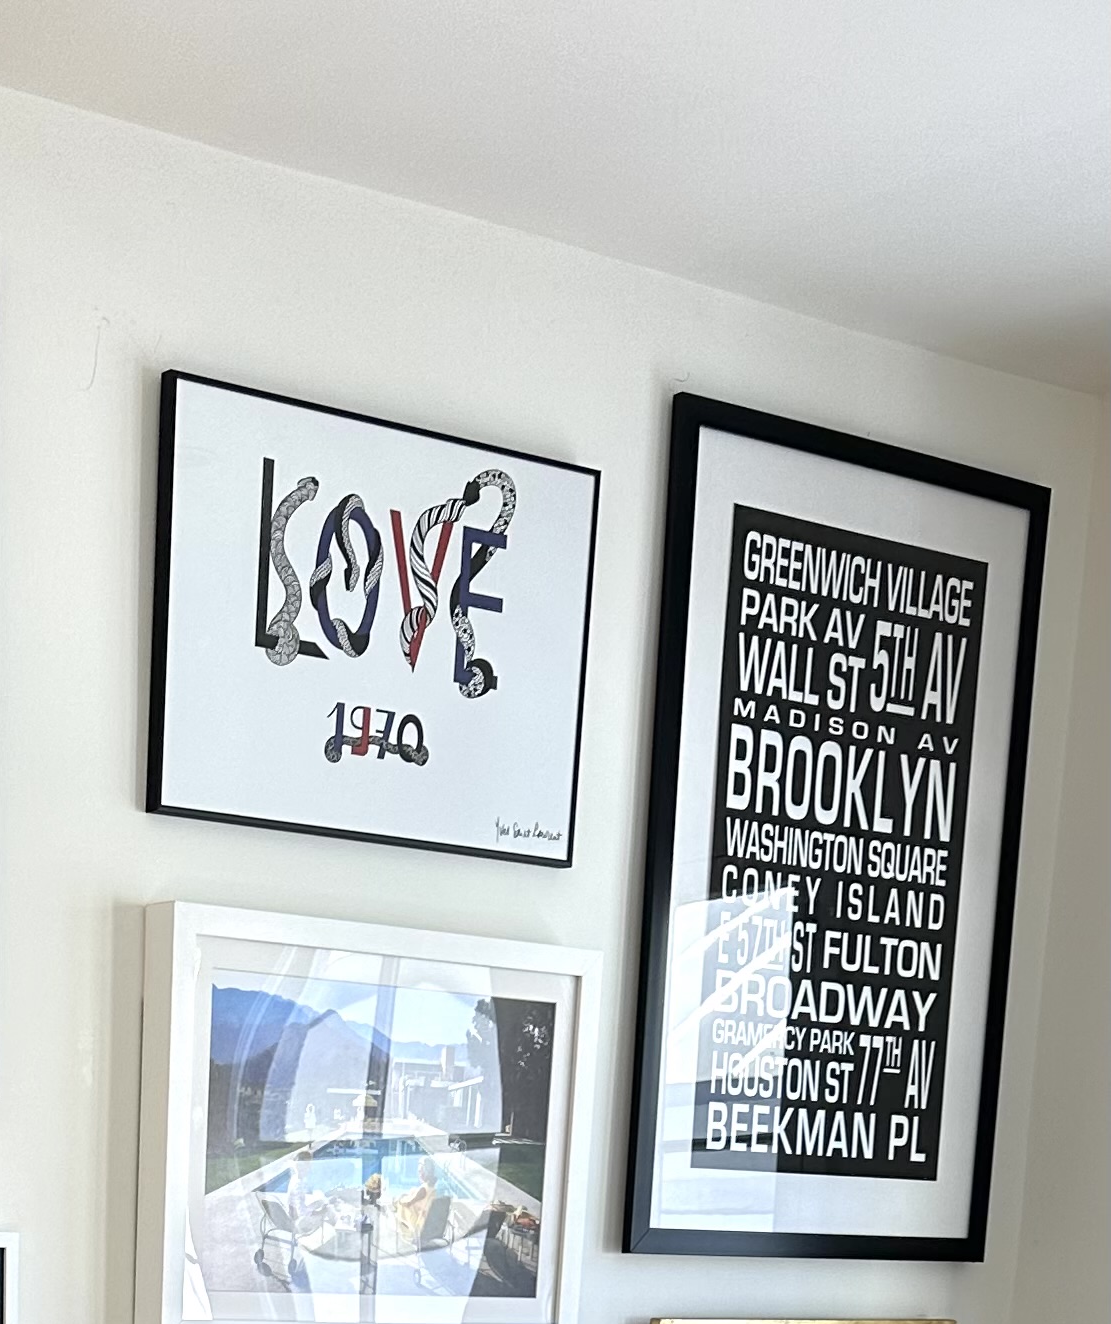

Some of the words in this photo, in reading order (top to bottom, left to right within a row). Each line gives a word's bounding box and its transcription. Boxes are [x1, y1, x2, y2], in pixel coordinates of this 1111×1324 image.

[255, 456, 516, 699] LOVE
[743, 530, 882, 608] GREENWICH
[888, 563, 974, 627] VILLAGE
[740, 587, 820, 641] PARK
[823, 607, 866, 650] AV
[738, 632, 820, 706] WALL
[826, 653, 866, 713] ST
[870, 620, 919, 716] 5TH
[920, 632, 967, 725] AV
[324, 702, 429, 766] 1970
[733, 697, 896, 746] MADISON
[917, 733, 959, 755] AV
[726, 723, 957, 843] BROOKLYN
[725, 816, 864, 876] WASHINGTON
[867, 840, 948, 887] SQUARE
[722, 864, 821, 914] CONEY
[836, 881, 945, 930] ISLAND
[718, 911, 732, 964] E
[736, 915, 786, 971] 57TH
[791, 922, 818, 974] ST
[823, 930, 942, 981] FULTON
[713, 969, 938, 1032] BROADWAY
[713, 1018, 807, 1052] GRAMERCY
[809, 1029, 854, 1056] PARK
[710, 1050, 820, 1102] HOUSTON
[824, 1061, 854, 1104] ST
[857, 1034, 903, 1106] 77TH
[904, 1039, 936, 1110] AV
[706, 1101, 876, 1160] BEEKMAN
[888, 1114, 927, 1162] PL
